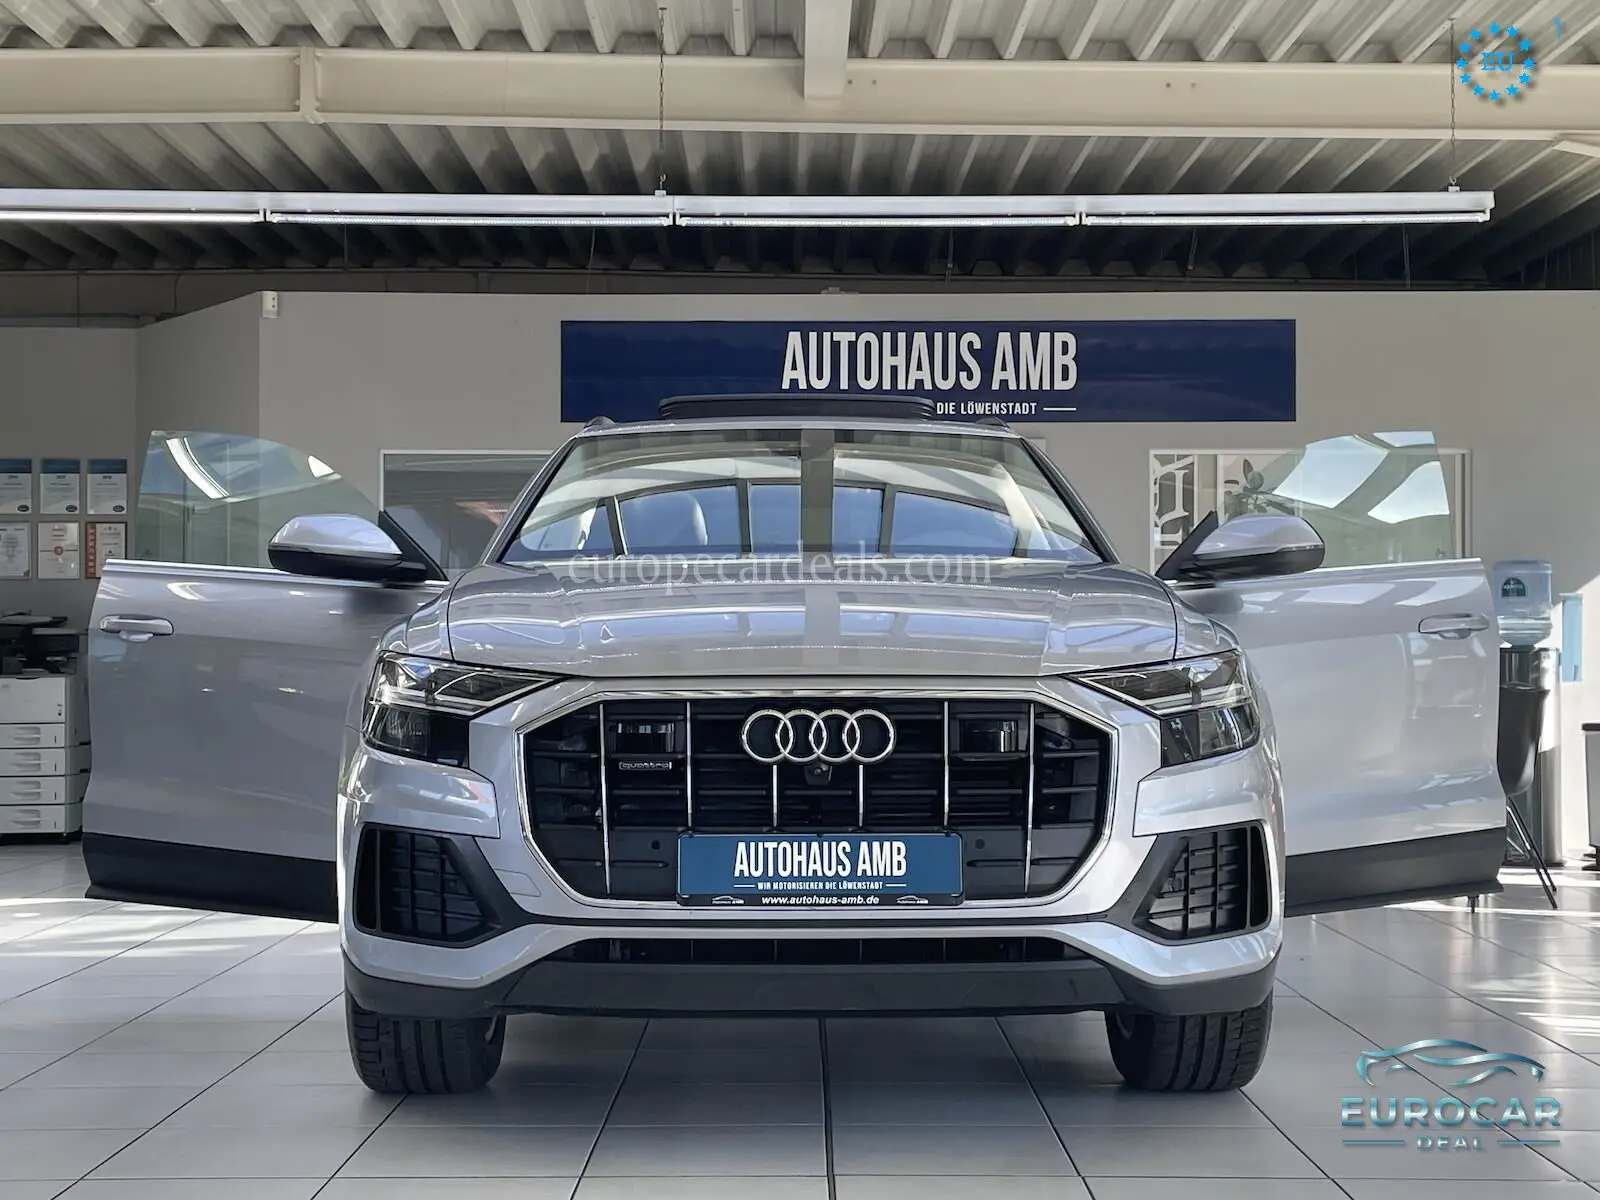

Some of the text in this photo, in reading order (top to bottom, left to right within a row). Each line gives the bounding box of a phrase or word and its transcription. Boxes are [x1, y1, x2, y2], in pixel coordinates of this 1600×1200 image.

[781, 331, 1077, 390] AUTOHAUS AMB
[936, 401, 1037, 415] DIE LÖWENSTADT
[734, 841, 907, 877] AUTOHAUS AMB
[757, 881, 883, 890] WIR MOTORISIEREN DIE LÖWENSTADT
[761, 895, 880, 905] www.autohaus-amb.de
